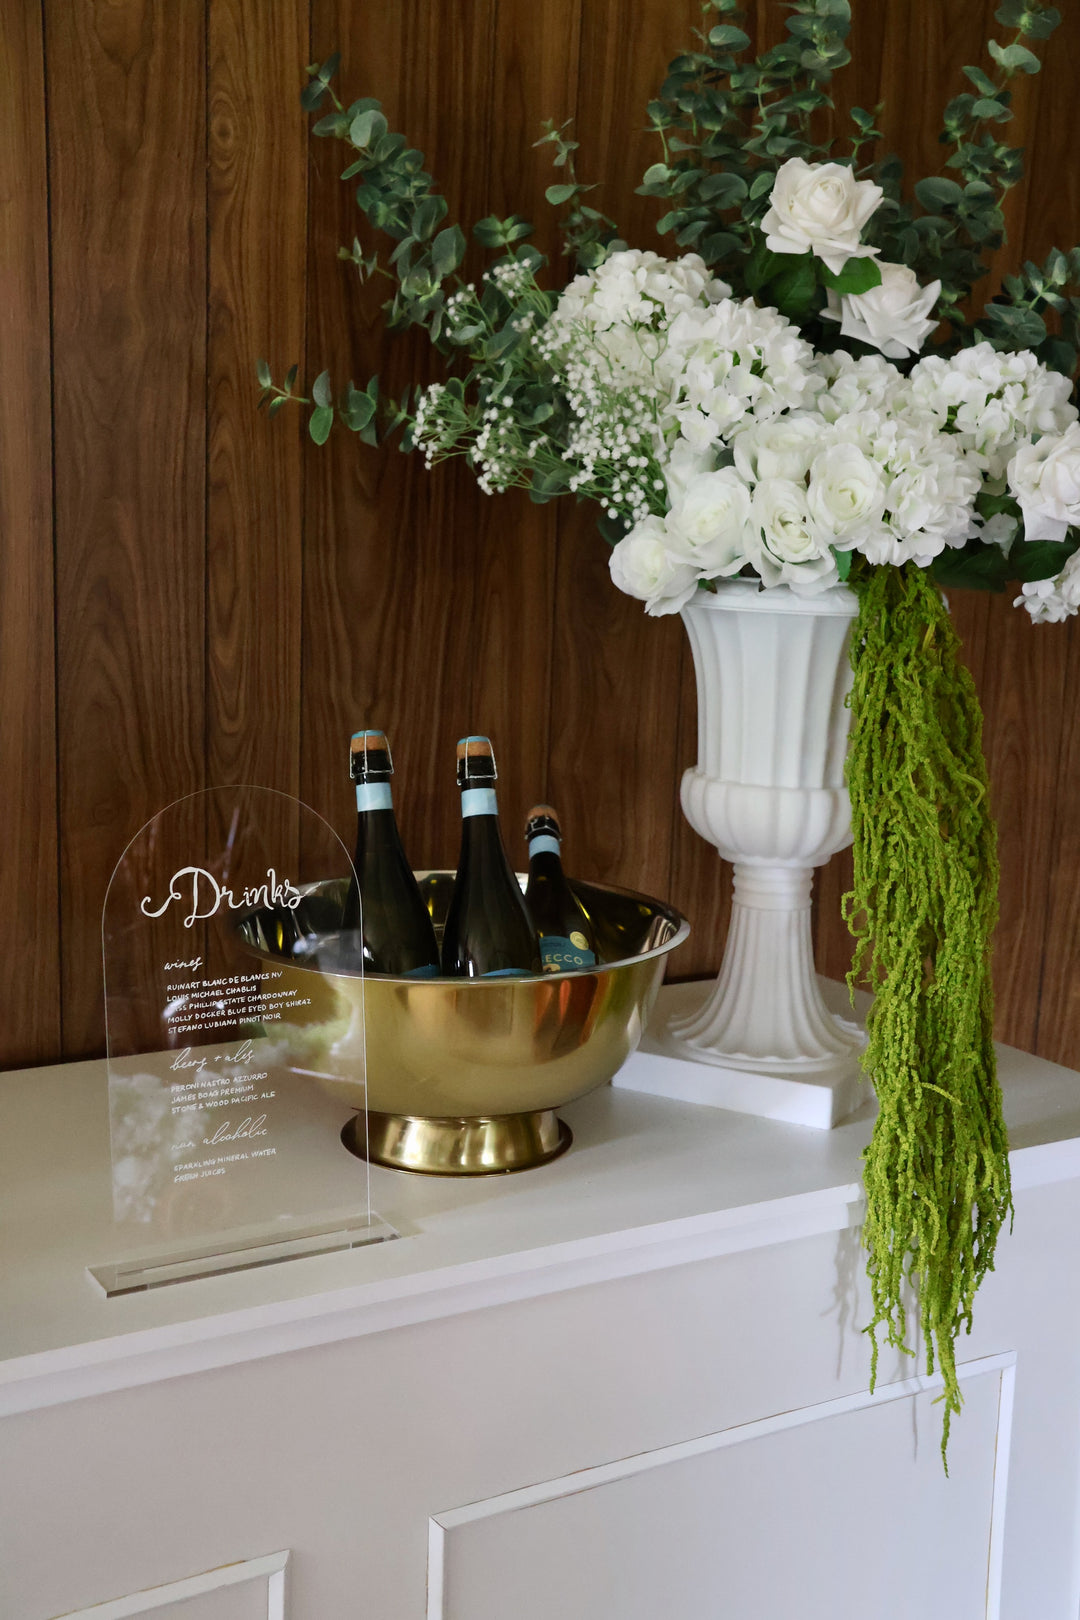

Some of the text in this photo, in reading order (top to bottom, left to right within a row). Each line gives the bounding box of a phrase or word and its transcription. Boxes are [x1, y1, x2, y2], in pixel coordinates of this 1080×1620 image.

[140, 866, 304, 928] Drinks
[164, 956, 203, 972] wines
[542, 953, 584, 965] ECCO
[167, 970, 283, 991] RUINART BLANC DE BLANCS NV
[167, 985, 257, 1002] LOUIS MICHAEL CHABLIS
[189, 1001, 217, 1010] PHILLIP
[217, 996, 246, 1006] ESTATE
[248, 989, 298, 1002] CHARDONNAY
[168, 999, 312, 1024] MOLLY DOCKER BLUE EYED BOY SHIRAZ
[168, 1012, 282, 1034] STEFANO LUBIANA PINOT NOIR
[170, 1047, 208, 1072] beers
[224, 1039, 255, 1064] ales
[170, 1072, 268, 1093] PERONI NASTRO AZZURRO
[171, 1094, 196, 1104] JAMES
[220, 1085, 254, 1096] PREMIUM
[172, 1104, 198, 1114] STONE
[206, 1100, 229, 1108] WOOD
[232, 1094, 258, 1104] PACIFIC
[260, 1091, 276, 1099] ALE
[203, 1114, 268, 1144] alcoholic
[174, 1148, 276, 1171] SPARKLING MINERAL WATER
